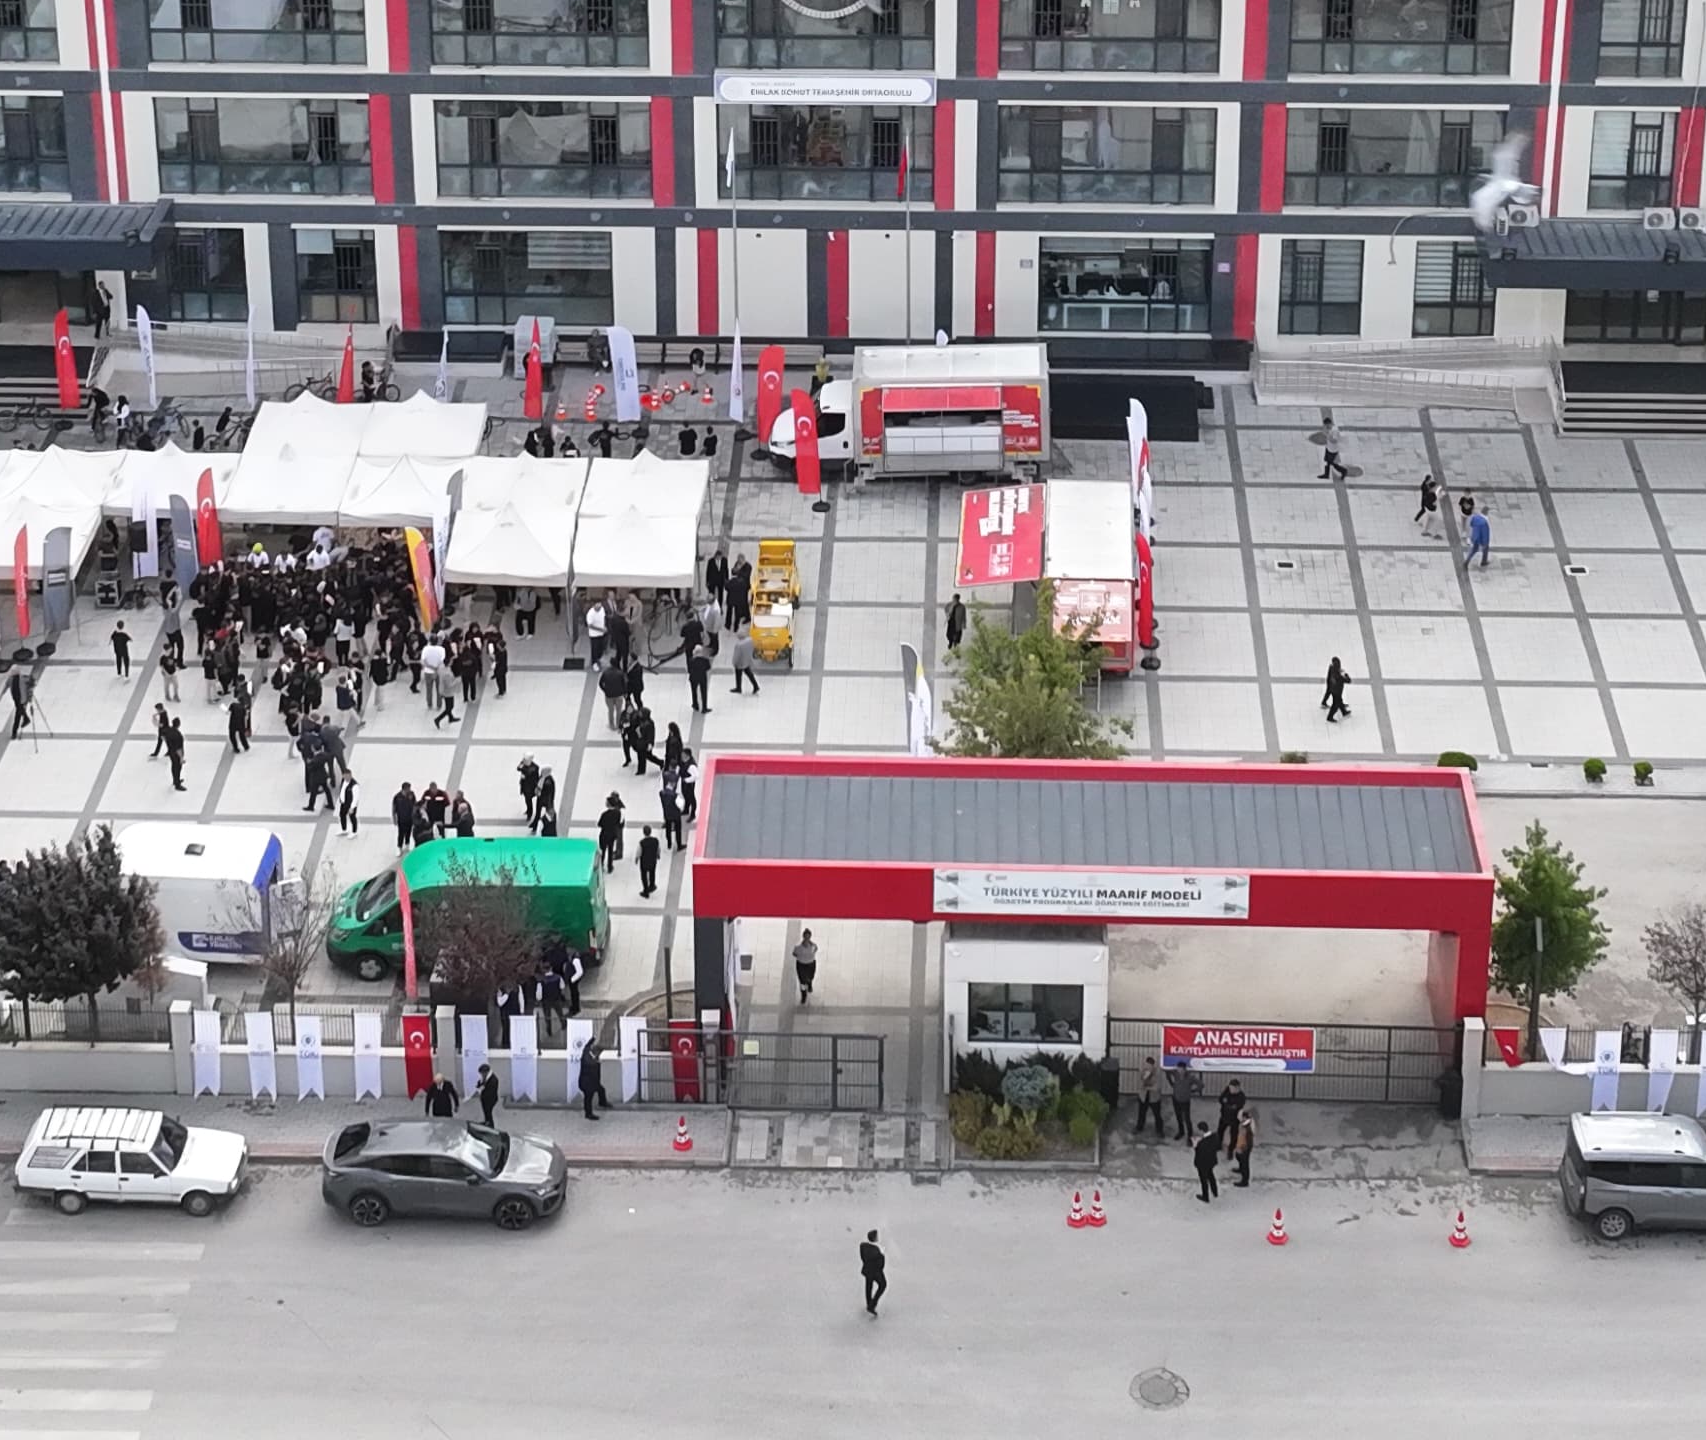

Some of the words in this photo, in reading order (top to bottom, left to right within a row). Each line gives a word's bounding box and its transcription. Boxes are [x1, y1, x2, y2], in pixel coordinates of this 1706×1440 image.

[750, 88, 779, 96] EMLAK
[983, 885, 1039, 898] TÜRKİYE
[1042, 886, 1093, 898] YÜZYILI
[1096, 888, 1148, 900] MAARİF
[1151, 889, 1202, 901] MODELİ
[1194, 1031, 1284, 1047] ANASINIFI
[1170, 1046, 1239, 1057] KAYITLARIMIZ
[1241, 1048, 1307, 1058] BAŞLAMIŞTIR
